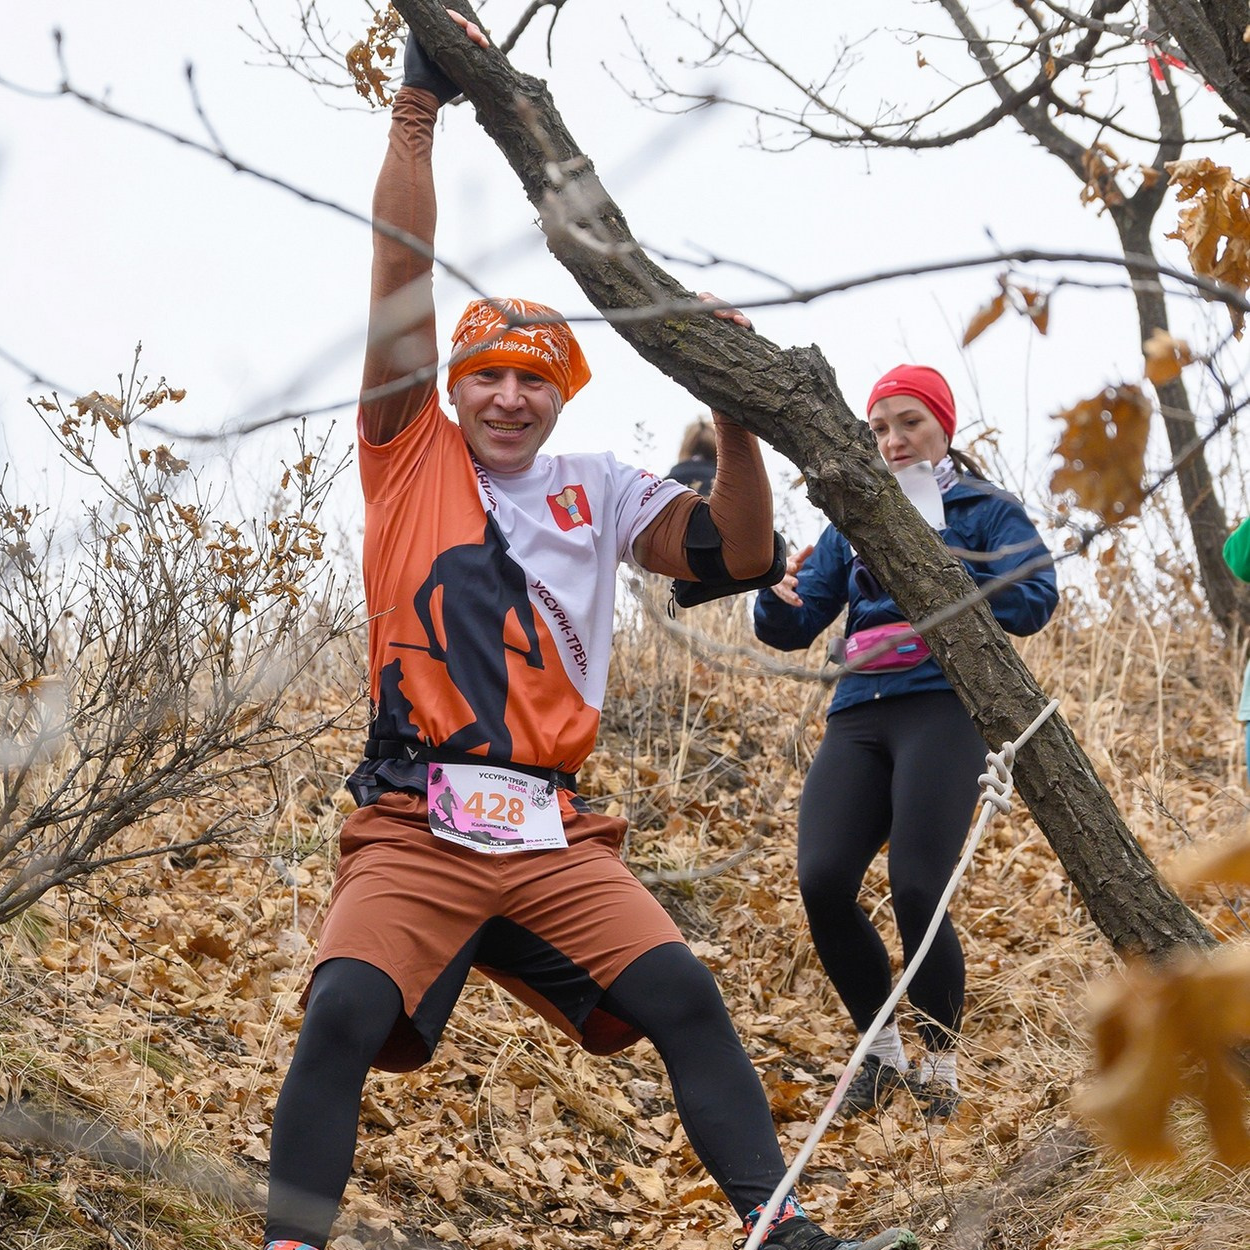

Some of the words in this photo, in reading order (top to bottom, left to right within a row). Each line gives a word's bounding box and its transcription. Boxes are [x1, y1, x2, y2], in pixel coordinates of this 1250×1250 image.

[478, 772, 528, 788] УССУРИ-ТРЕЙЛ
[507, 784, 527, 794] ВЕСНА
[463, 791, 526, 826] 428
